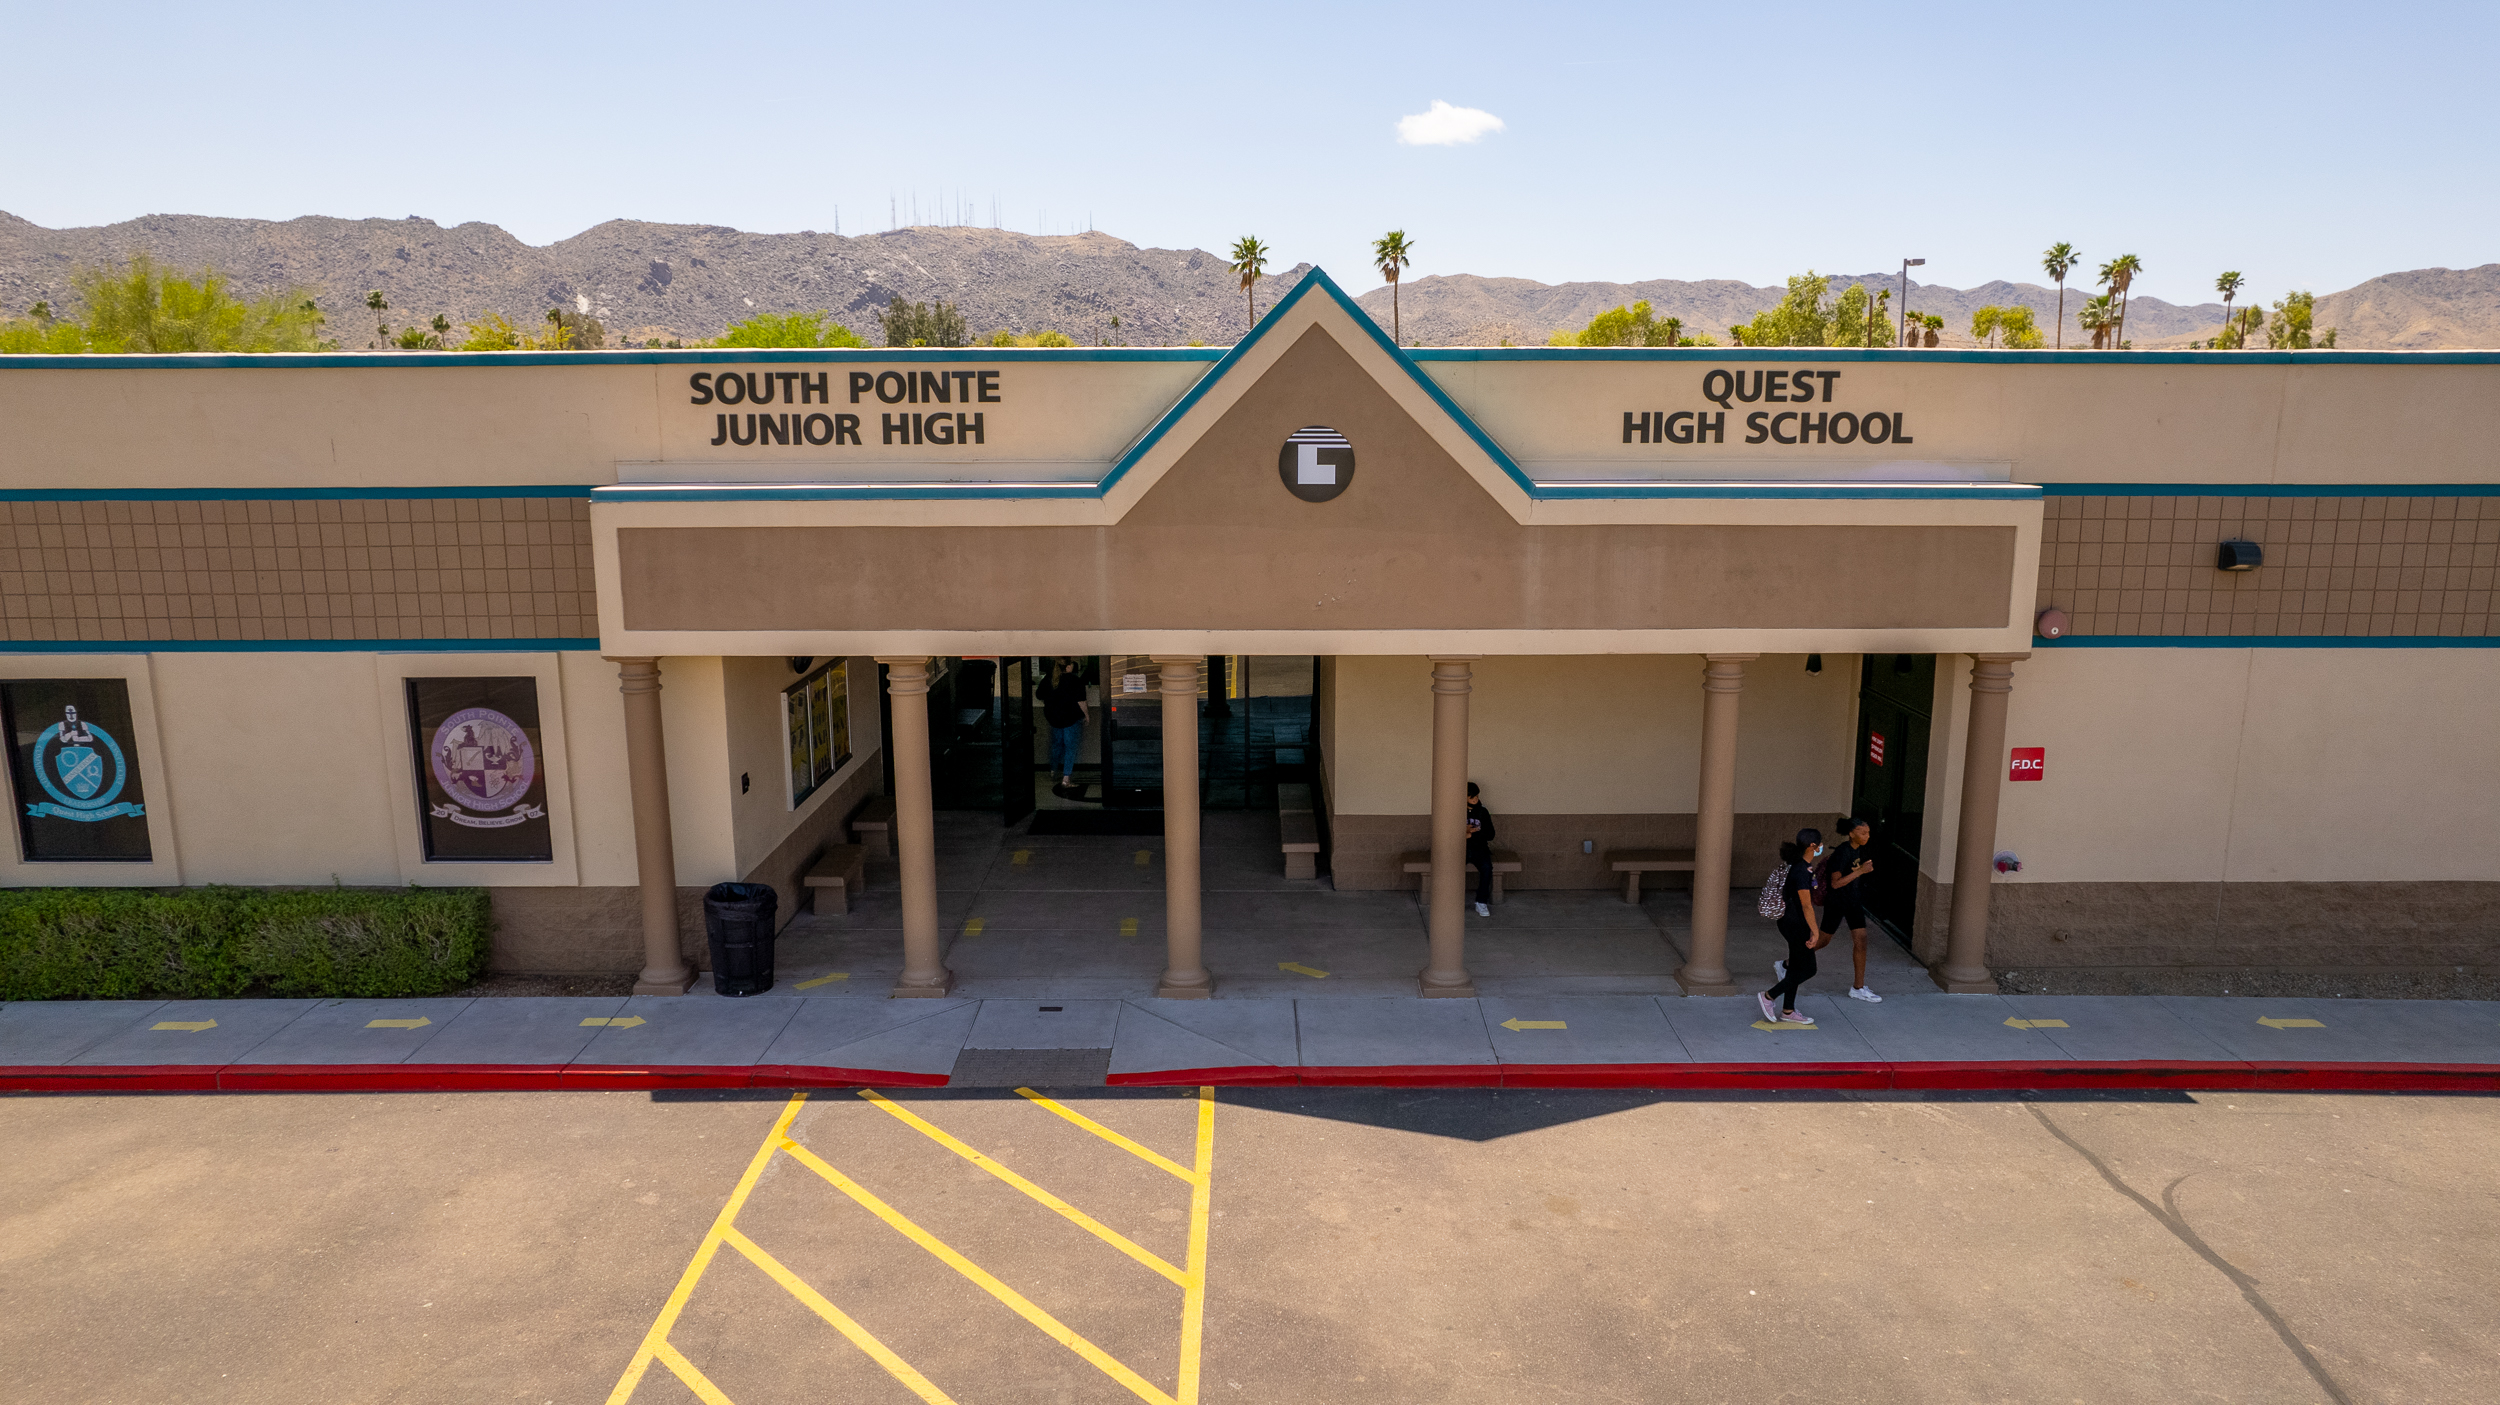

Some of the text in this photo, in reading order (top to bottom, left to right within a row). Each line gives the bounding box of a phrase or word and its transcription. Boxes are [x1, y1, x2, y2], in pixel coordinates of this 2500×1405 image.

[690, 370, 1001, 405] SOUTH POINTE
[1702, 369, 1841, 410] QUEST
[710, 412, 985, 446] JUNIOR HIGH
[1622, 411, 1914, 444] HIGH SCHOOL
[441, 710, 520, 736] SOUTH POINTE
[2011, 759, 2043, 770] F.D.C.
[440, 780, 530, 811] JUNIOR HIGH SCHOOL
[53, 805, 120, 822] Quest High School
[505, 815, 524, 825] GROW
